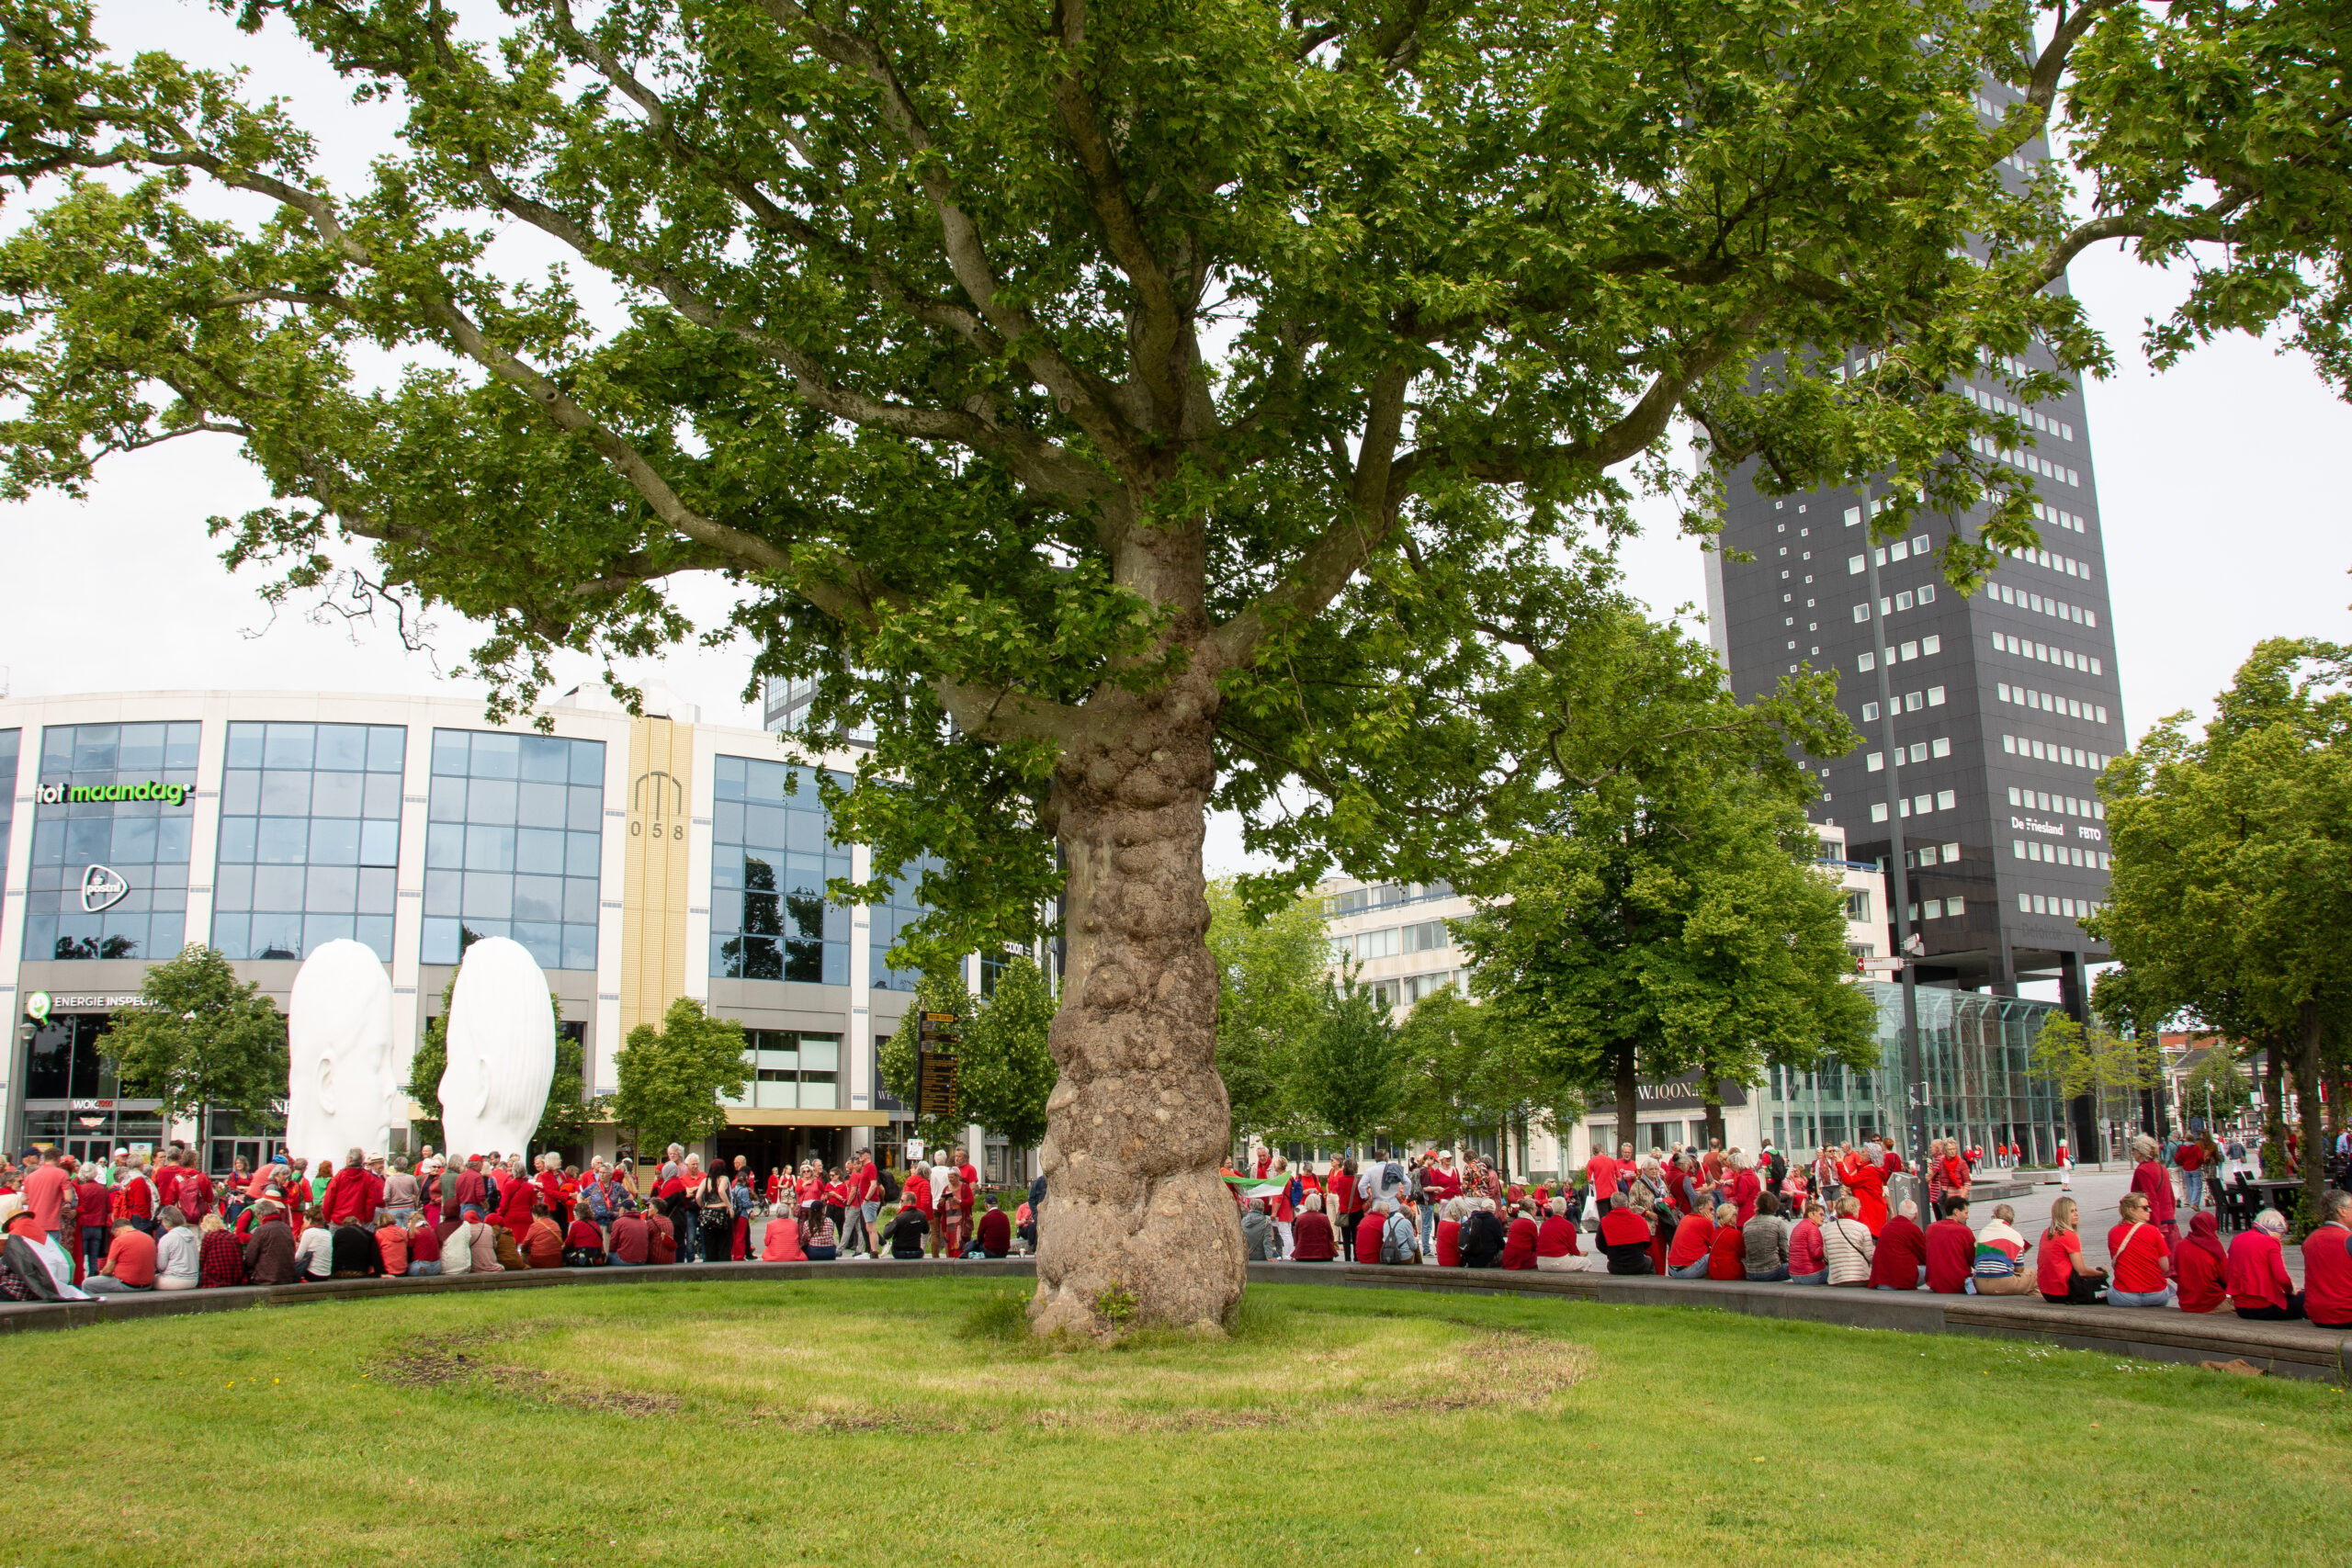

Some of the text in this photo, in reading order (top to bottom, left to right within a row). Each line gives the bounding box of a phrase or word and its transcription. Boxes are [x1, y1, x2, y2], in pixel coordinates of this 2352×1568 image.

[36, 779, 184, 807] tot maandag
[2010, 816, 2064, 836] De Friesland
[2078, 826, 2103, 841] FBTO
[55, 996, 104, 1007] ENERGIE
[74, 1100, 99, 1110] WOK
